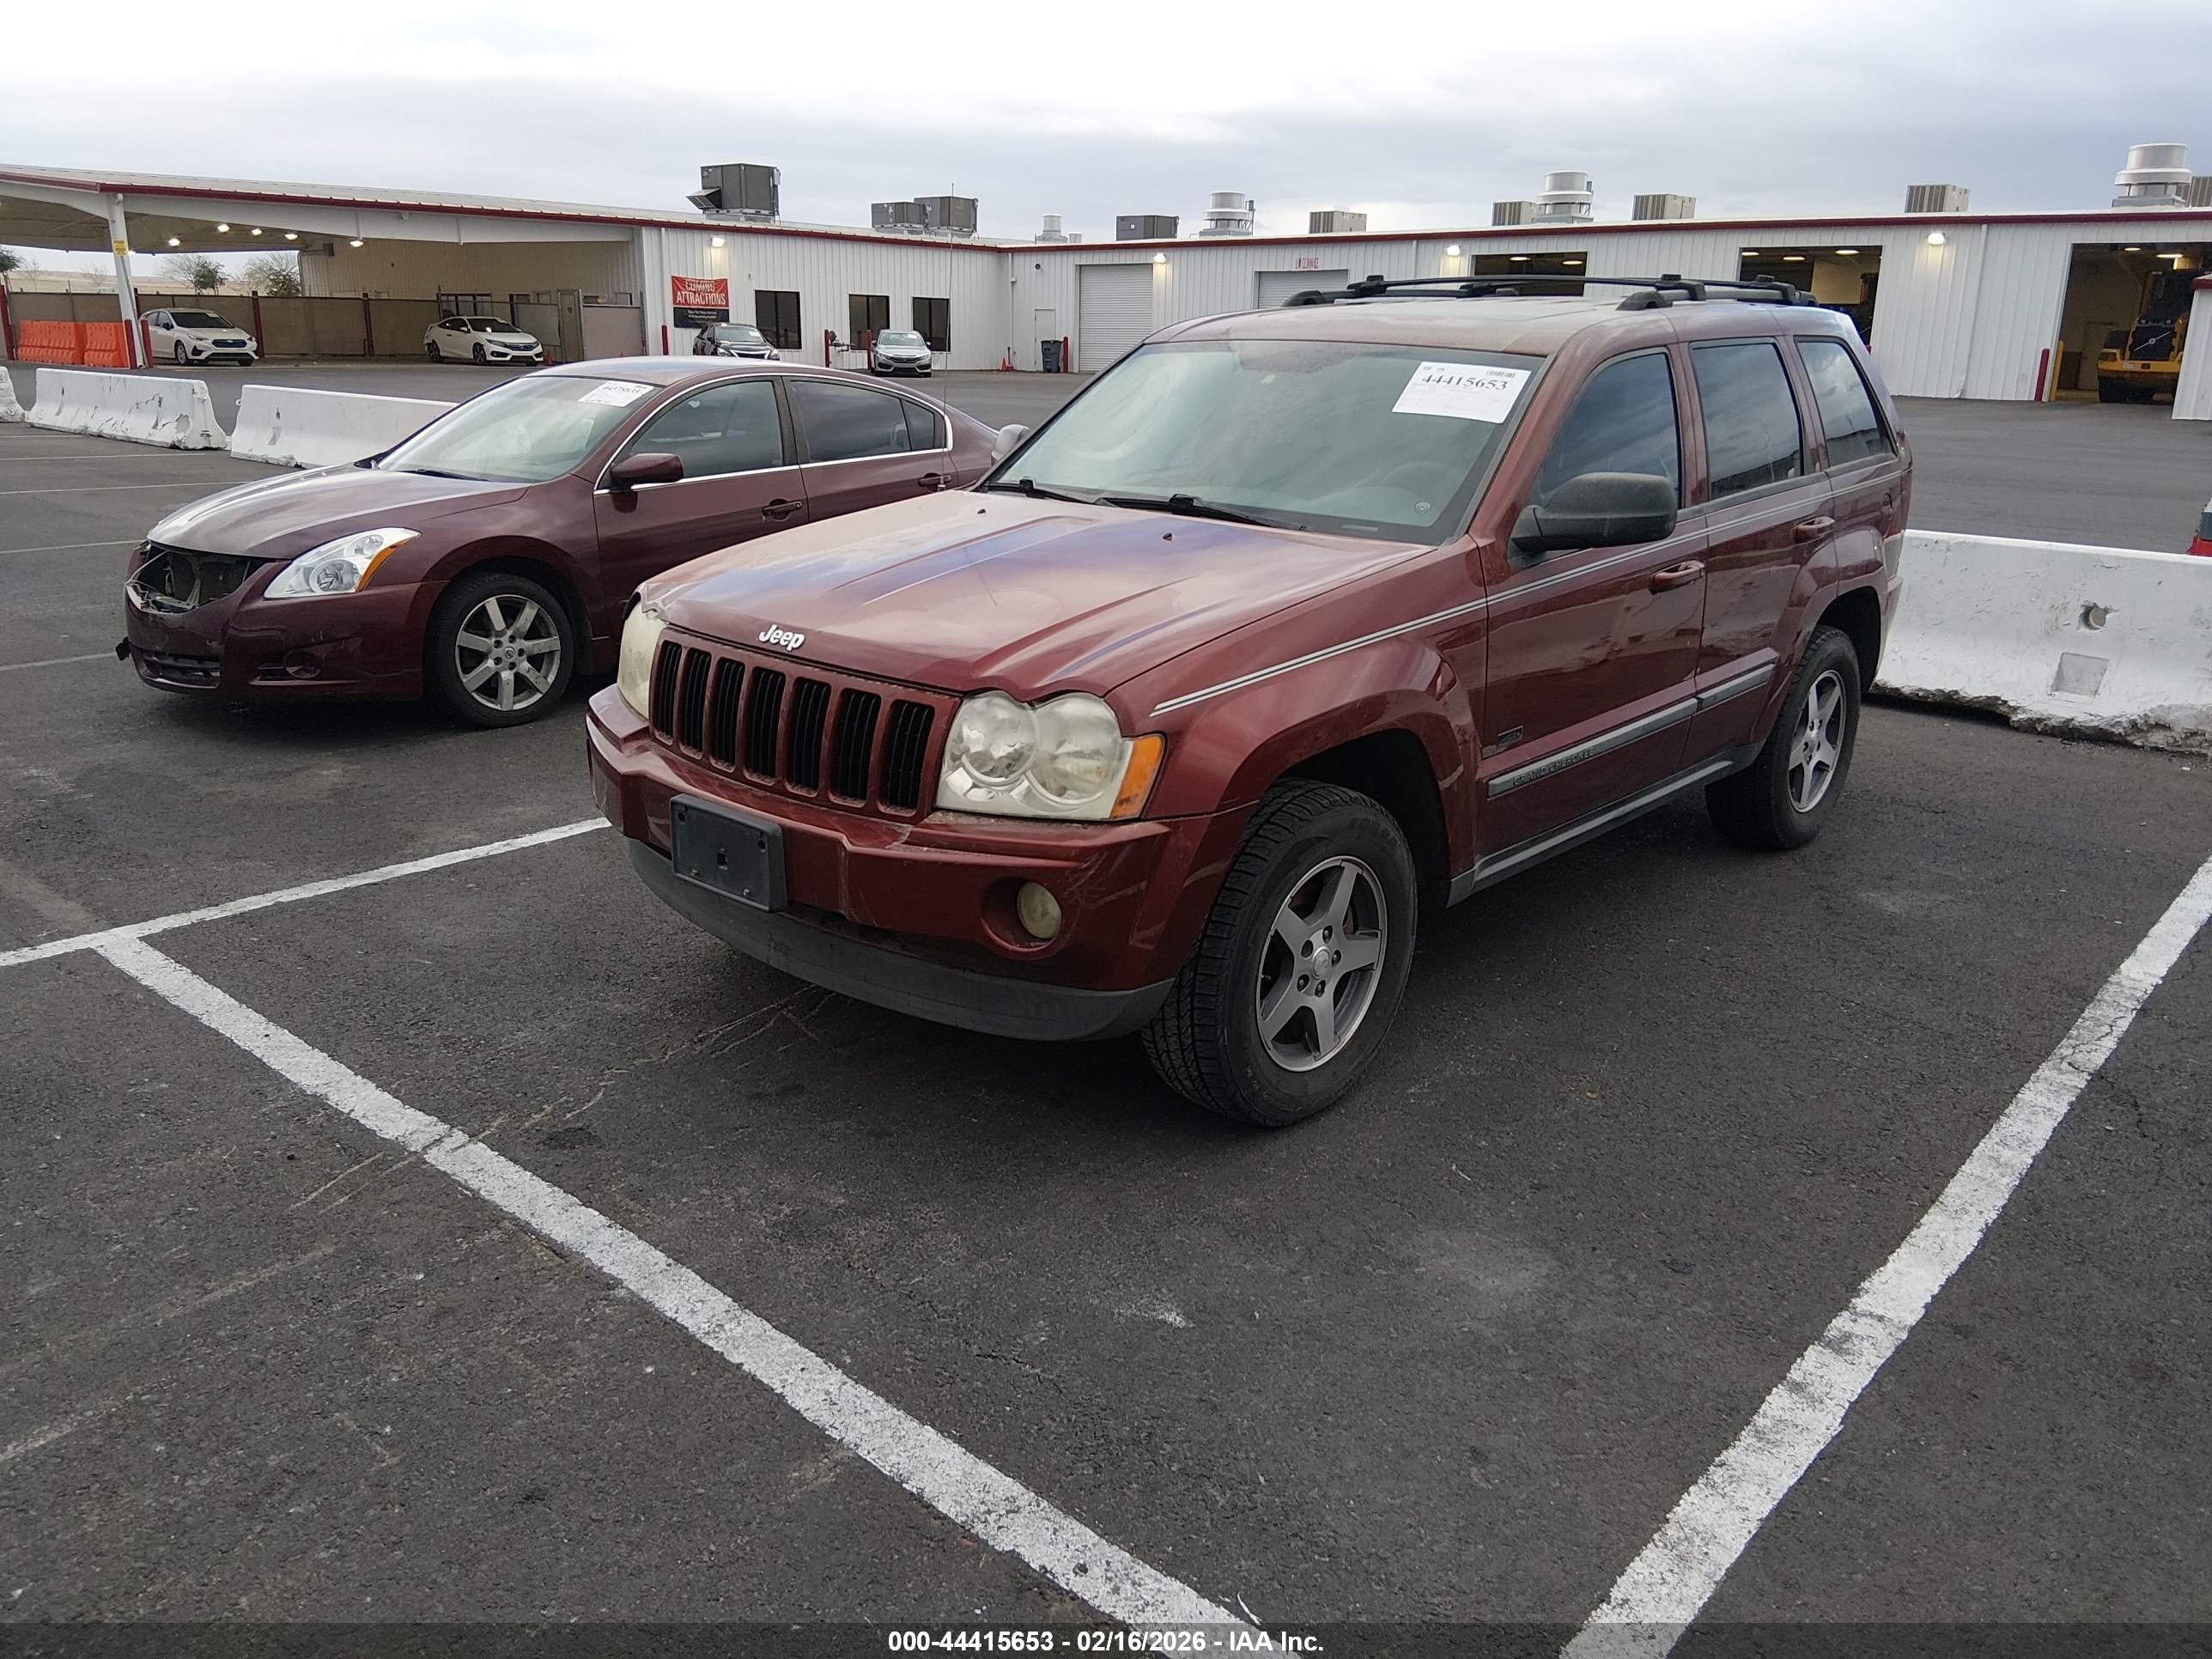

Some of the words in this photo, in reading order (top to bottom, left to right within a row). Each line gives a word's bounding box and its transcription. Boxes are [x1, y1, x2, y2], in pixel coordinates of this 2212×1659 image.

[677, 291, 726, 306] ATTRACTIONS
[1422, 374, 1508, 391] 44415653
[758, 623, 805, 652] Jeep
